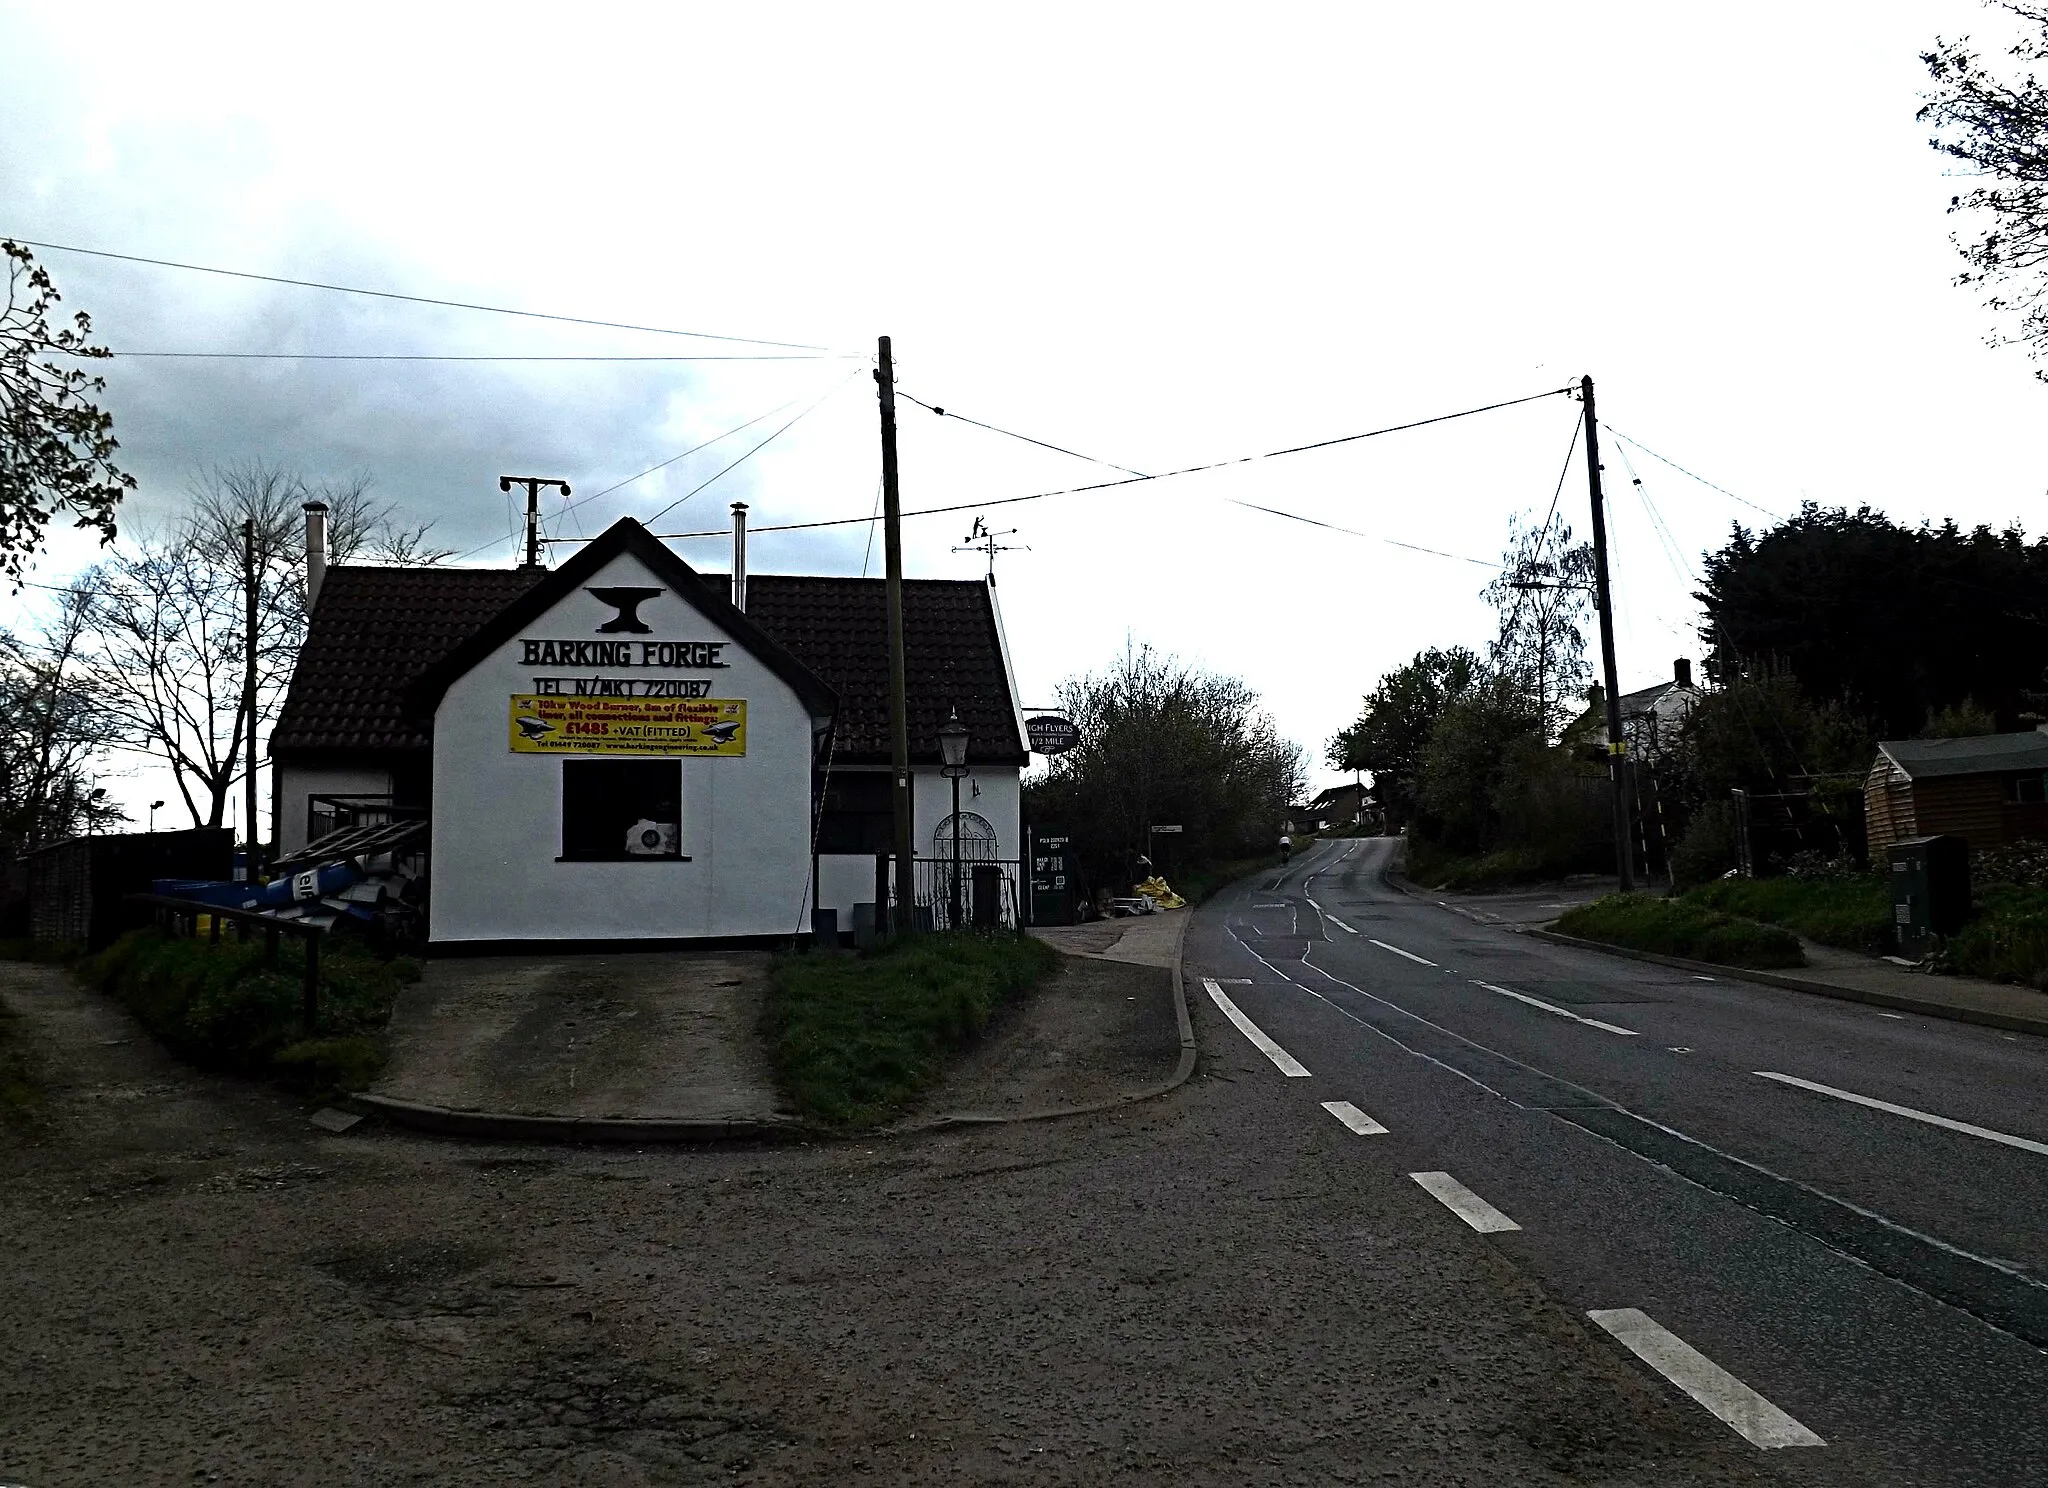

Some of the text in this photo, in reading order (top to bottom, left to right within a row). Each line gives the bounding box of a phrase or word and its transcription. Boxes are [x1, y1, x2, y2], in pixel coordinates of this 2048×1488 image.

[524, 641, 726, 667] BARKING FORGE
[533, 678, 566, 696] TEL
[641, 679, 712, 697] 720087
[569, 701, 600, 710] Wood
[602, 702, 642, 712] Burner,
[663, 703, 676, 712] of
[678, 703, 718, 713] flexible
[538, 710, 566, 720] liner,
[568, 711, 583, 720] all
[585, 711, 651, 722] connections
[653, 712, 672, 722] and
[566, 722, 609, 735] £1485
[613, 726, 642, 736] +VAT
[643, 725, 691, 738] (FITTED)
[1045, 723, 1074, 733] FLYERS
[1031, 737, 1065, 746] 1/2 MILE
